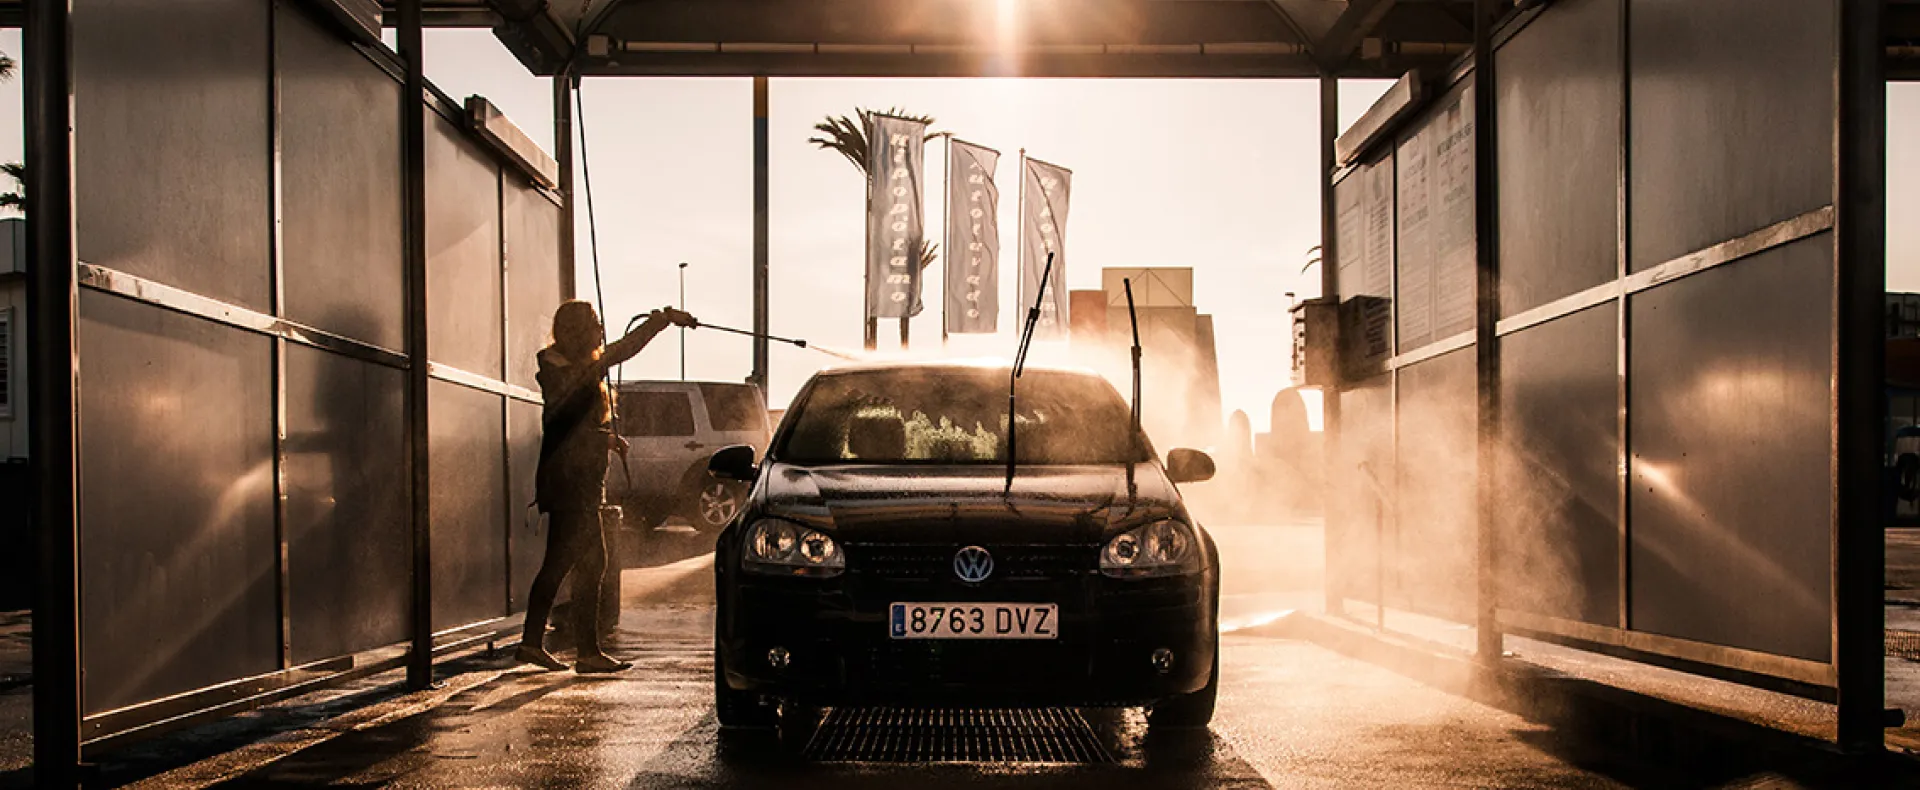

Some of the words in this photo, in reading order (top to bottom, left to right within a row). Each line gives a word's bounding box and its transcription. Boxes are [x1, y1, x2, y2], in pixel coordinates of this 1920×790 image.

[954, 545, 994, 582] VW
[911, 607, 985, 634] 8763
[996, 607, 1050, 634] DVZ
